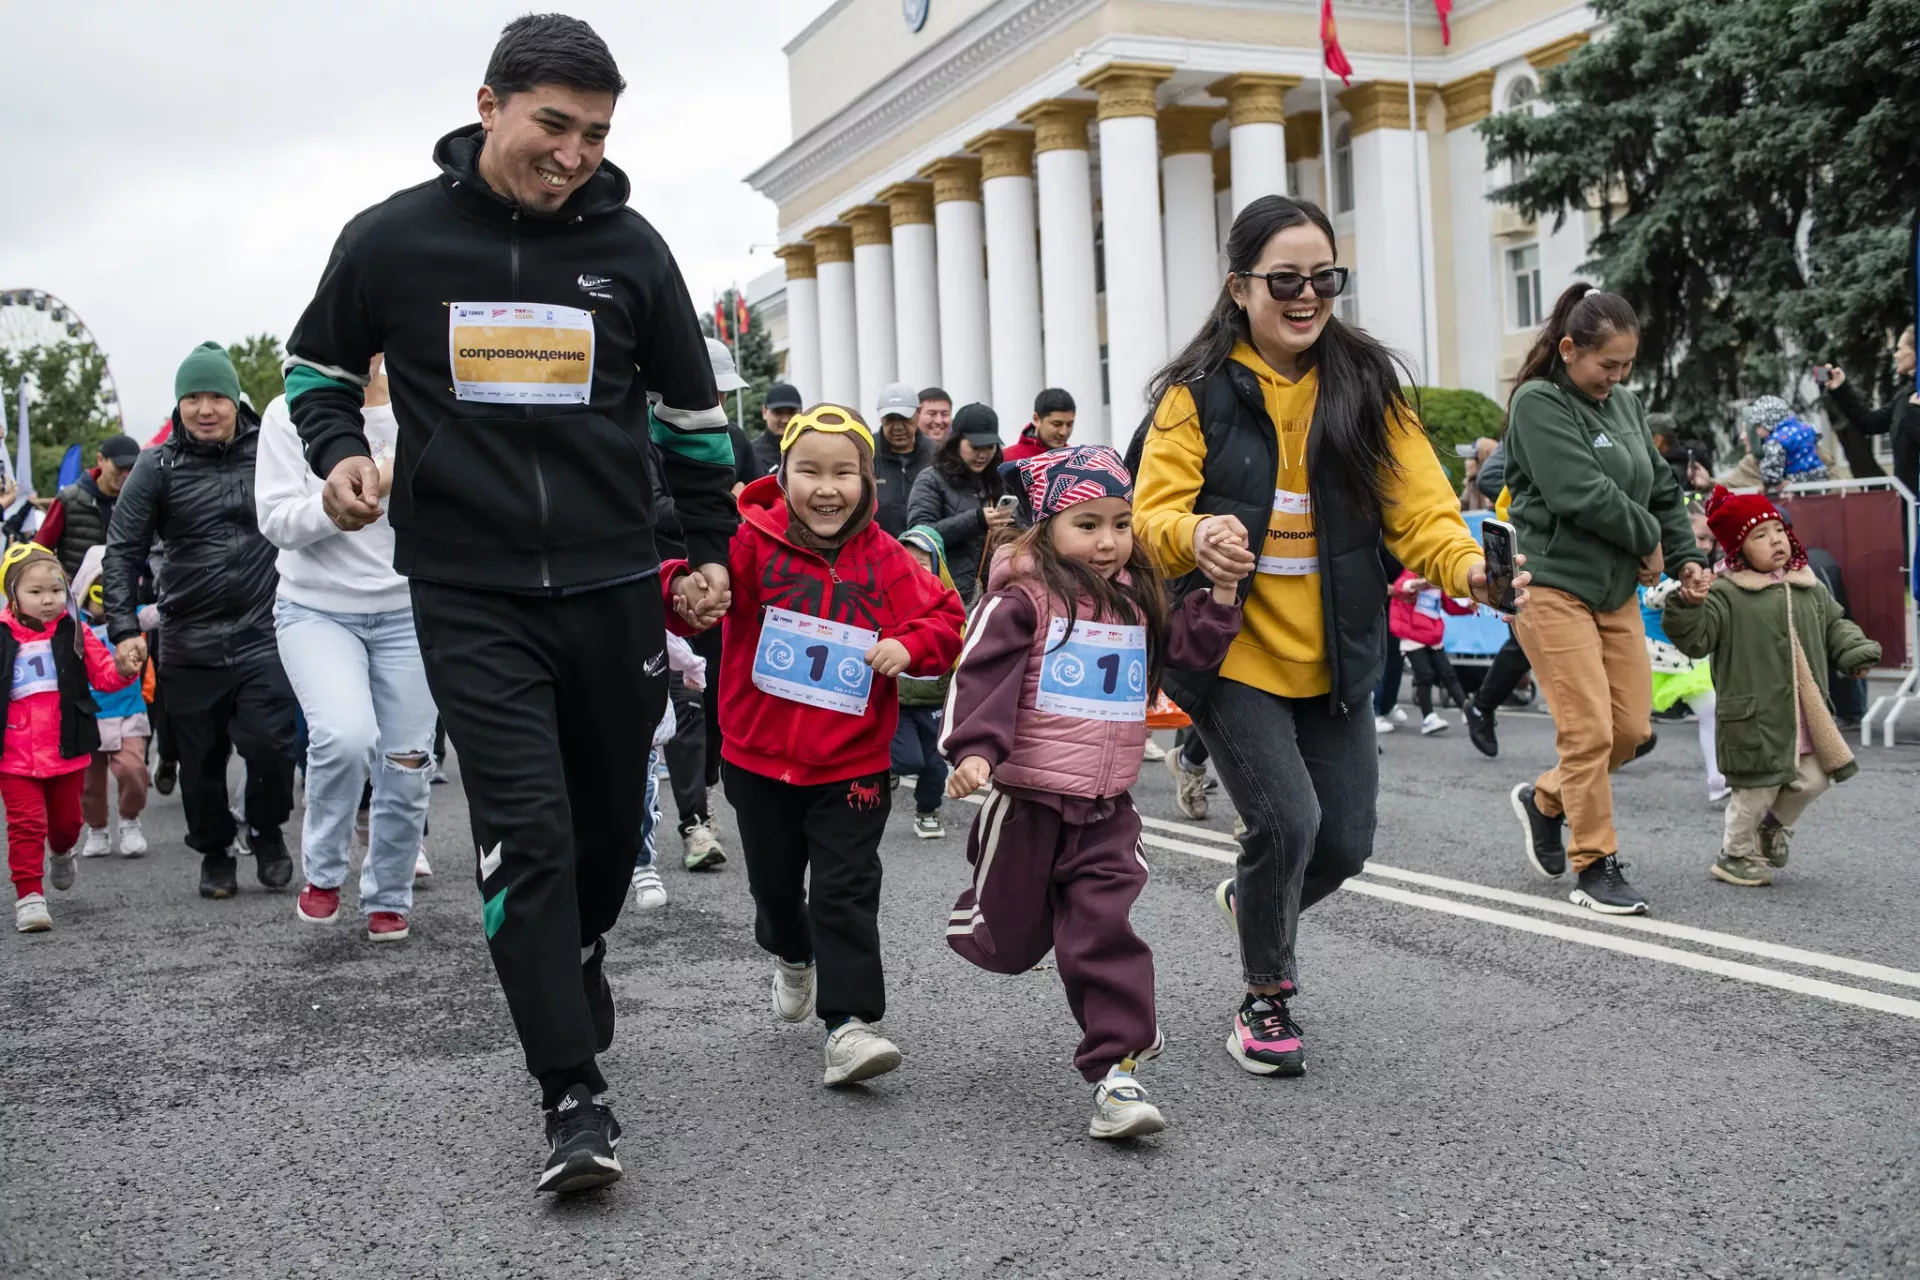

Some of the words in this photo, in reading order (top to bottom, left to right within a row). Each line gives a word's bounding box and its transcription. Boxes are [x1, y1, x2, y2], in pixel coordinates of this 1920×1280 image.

[459, 347, 585, 361] сопровождение
[28, 655, 45, 677] 1
[805, 644, 829, 682] 1
[1096, 653, 1120, 695] 1
